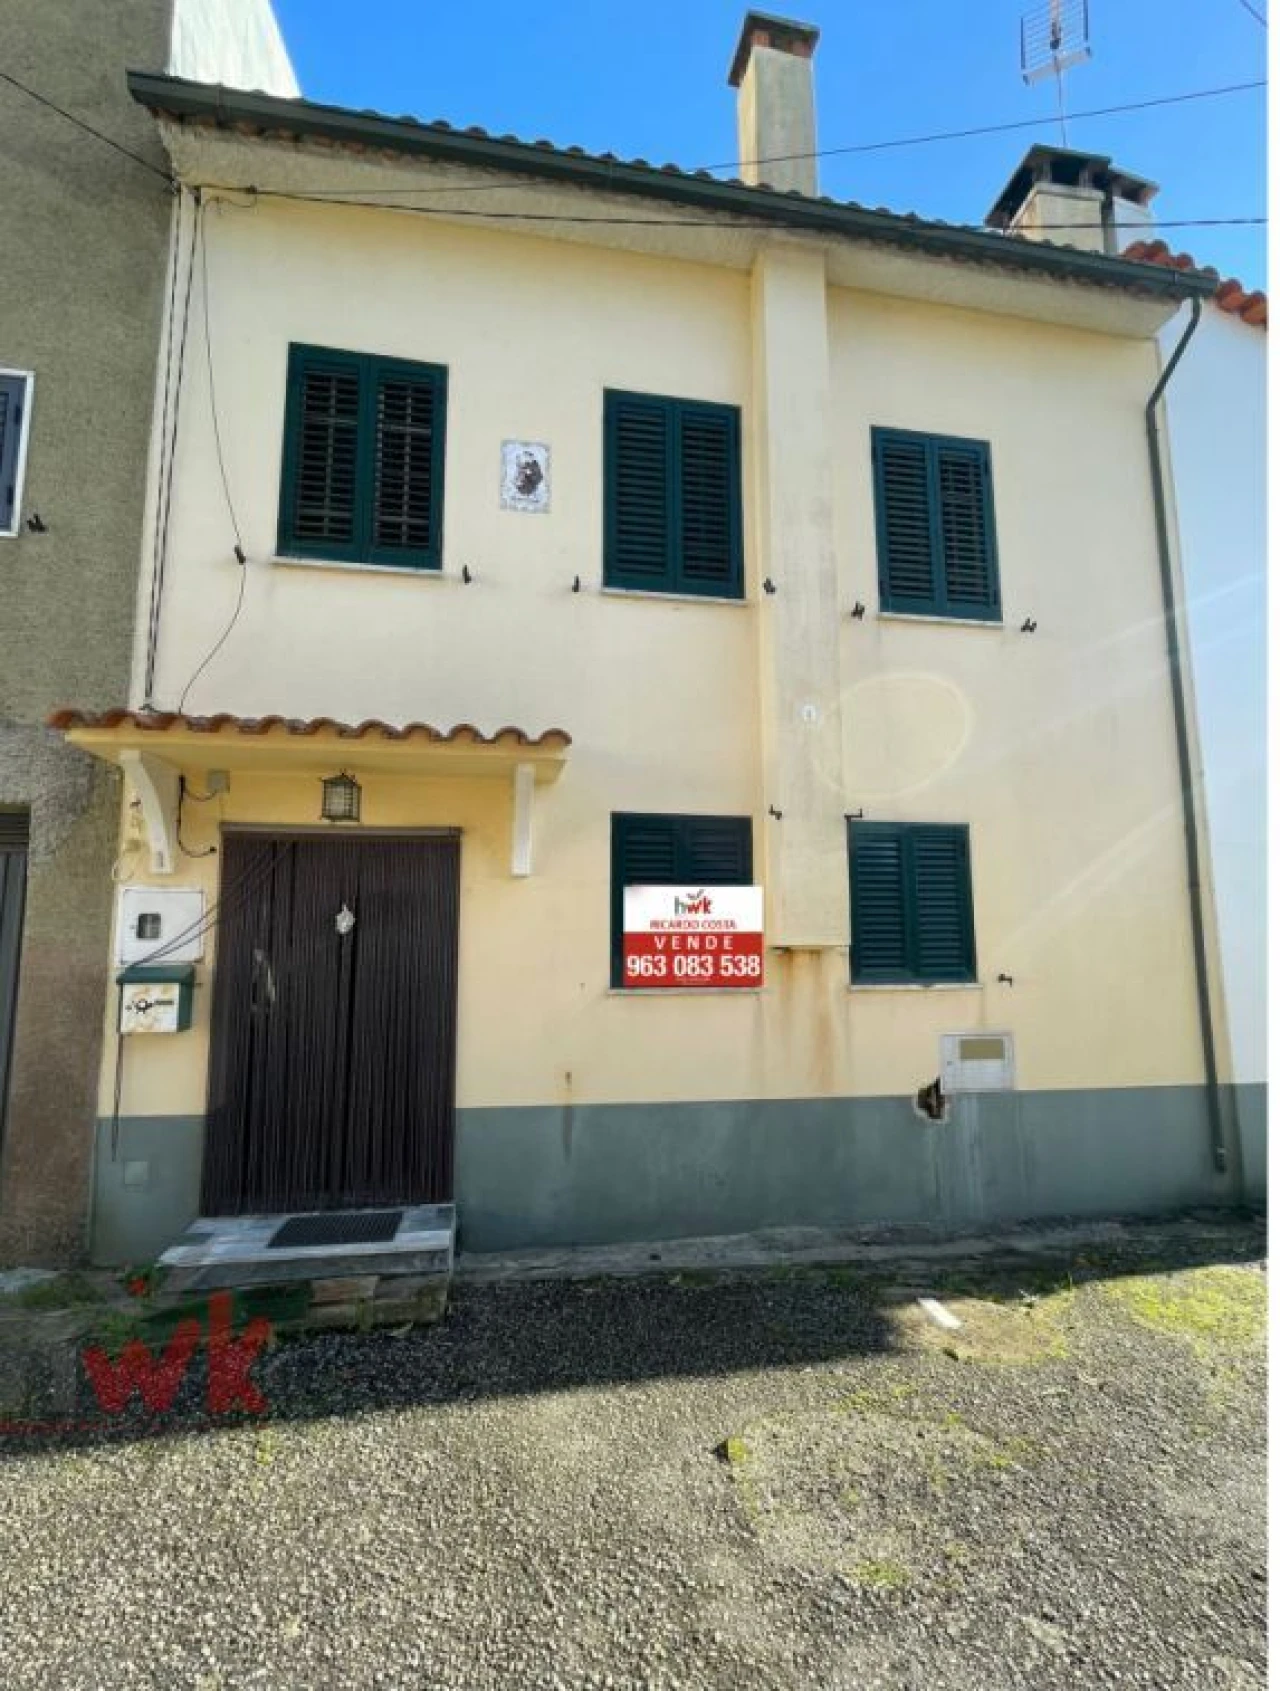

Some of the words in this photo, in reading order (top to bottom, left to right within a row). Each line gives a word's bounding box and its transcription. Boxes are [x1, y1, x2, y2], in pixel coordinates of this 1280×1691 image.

[674, 894, 712, 915] hwk
[650, 919, 699, 930] RICARDO
[701, 919, 737, 930] COSTA
[654, 935, 733, 950] VENDE
[627, 955, 666, 977] 963
[674, 955, 713, 977] 083
[720, 955, 760, 977] 538
